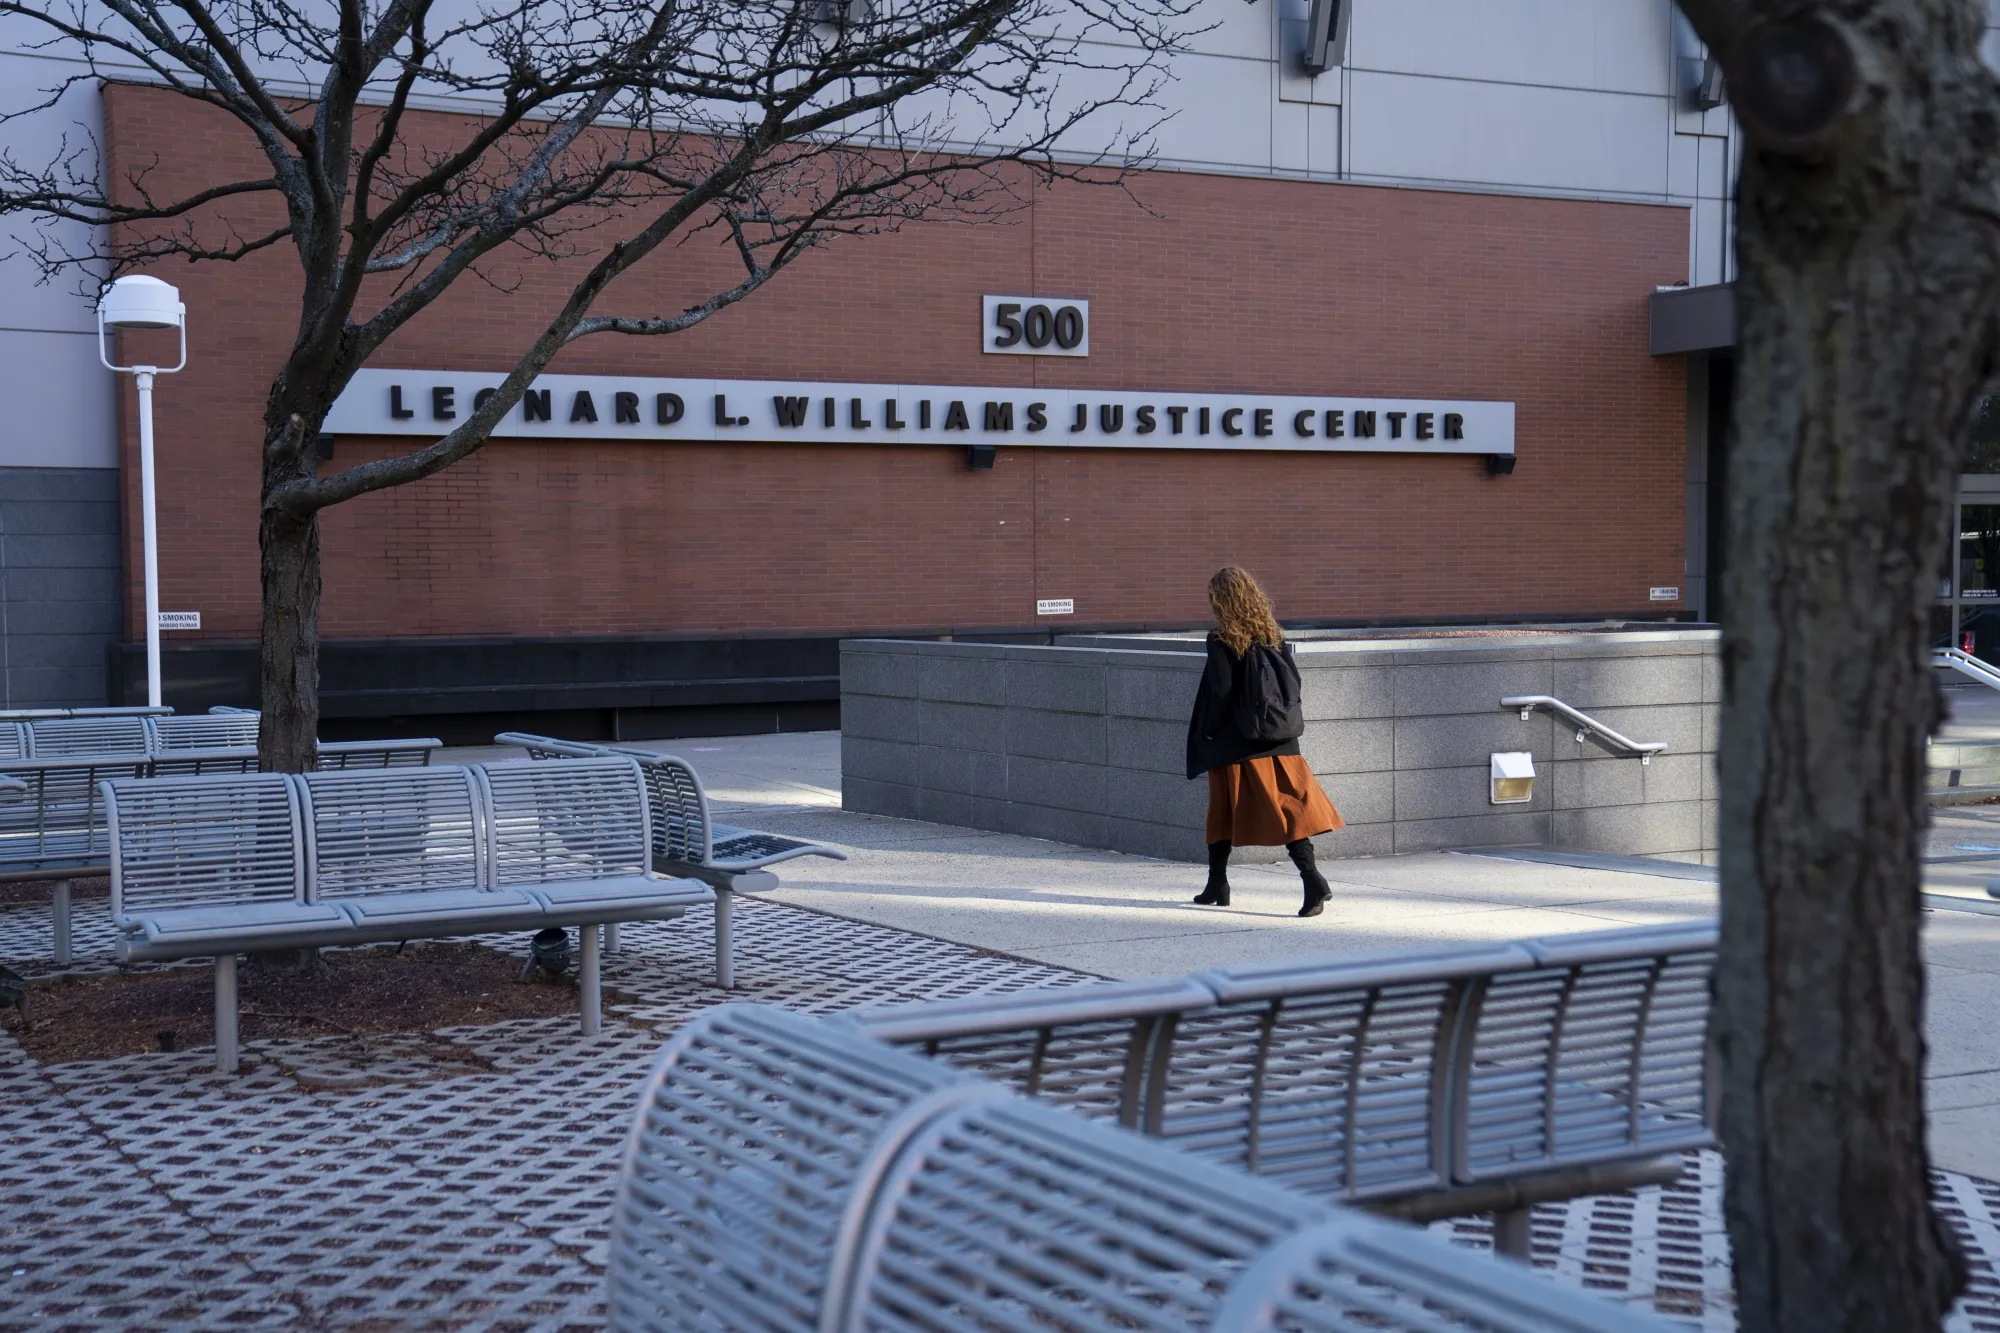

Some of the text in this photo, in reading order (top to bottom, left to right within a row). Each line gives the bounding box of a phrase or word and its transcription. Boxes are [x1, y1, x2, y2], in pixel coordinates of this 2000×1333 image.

[995, 303, 1084, 349] 500
[715, 394, 750, 426] L.
[773, 395, 1048, 431] WILLIAMS
[1070, 403, 1274, 434] JUSTICE
[1294, 409, 1464, 440] CENTER
